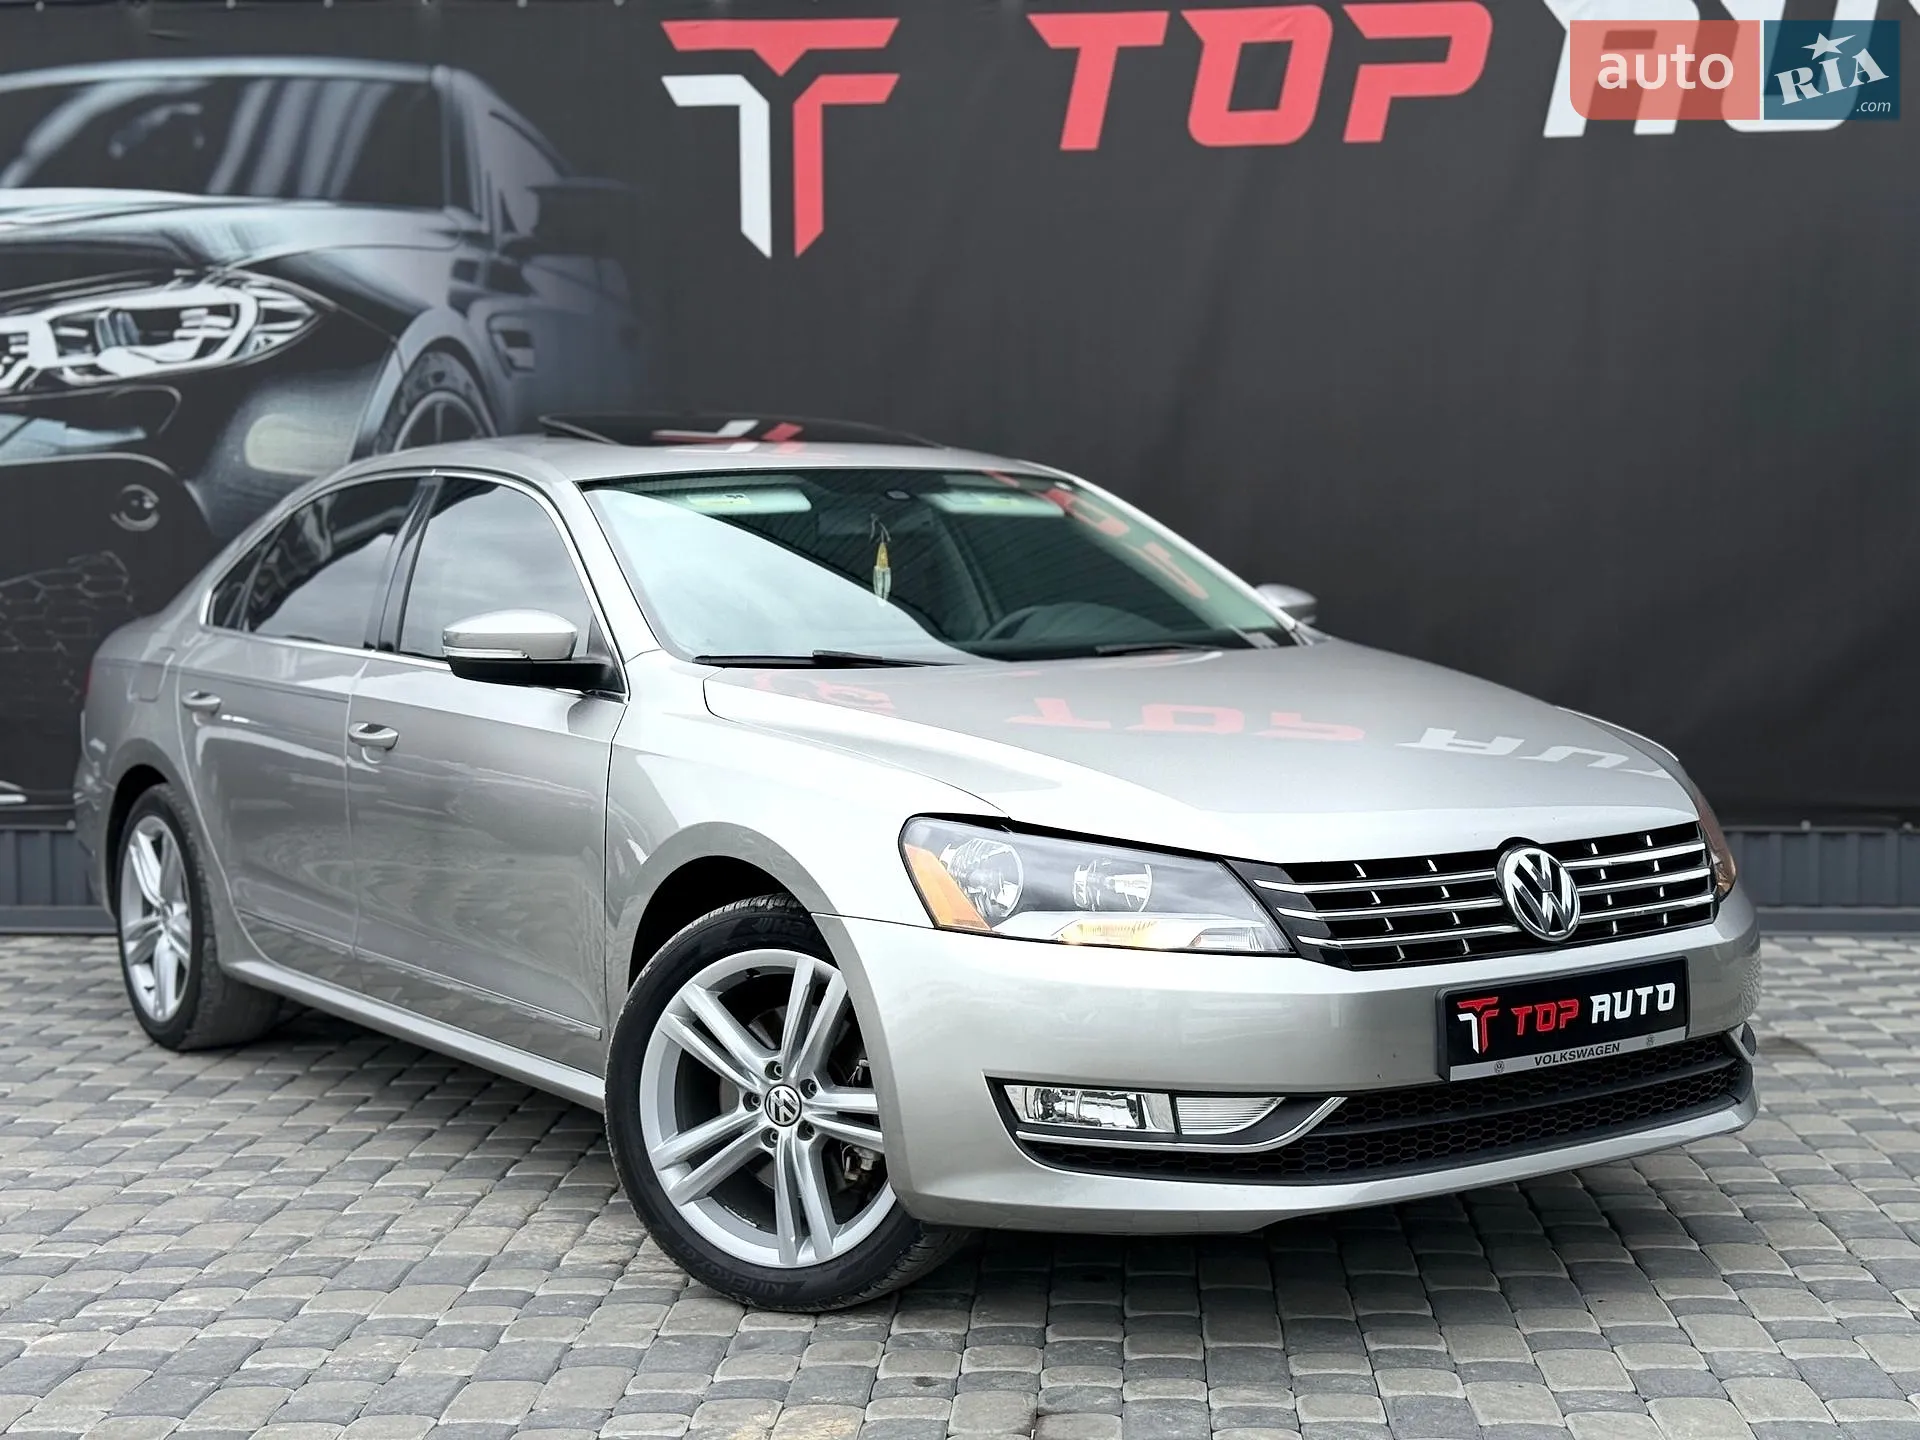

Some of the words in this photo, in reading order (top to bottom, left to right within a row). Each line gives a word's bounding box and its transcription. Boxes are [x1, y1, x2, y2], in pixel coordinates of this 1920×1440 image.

[1028, 1, 1493, 151] TOP
[1543, 0, 1920, 138] AU
[1510, 998, 1580, 1036] TOP
[1590, 982, 1676, 1024] AUTO
[1534, 1042, 1620, 1067] VOLKSWAGEN
